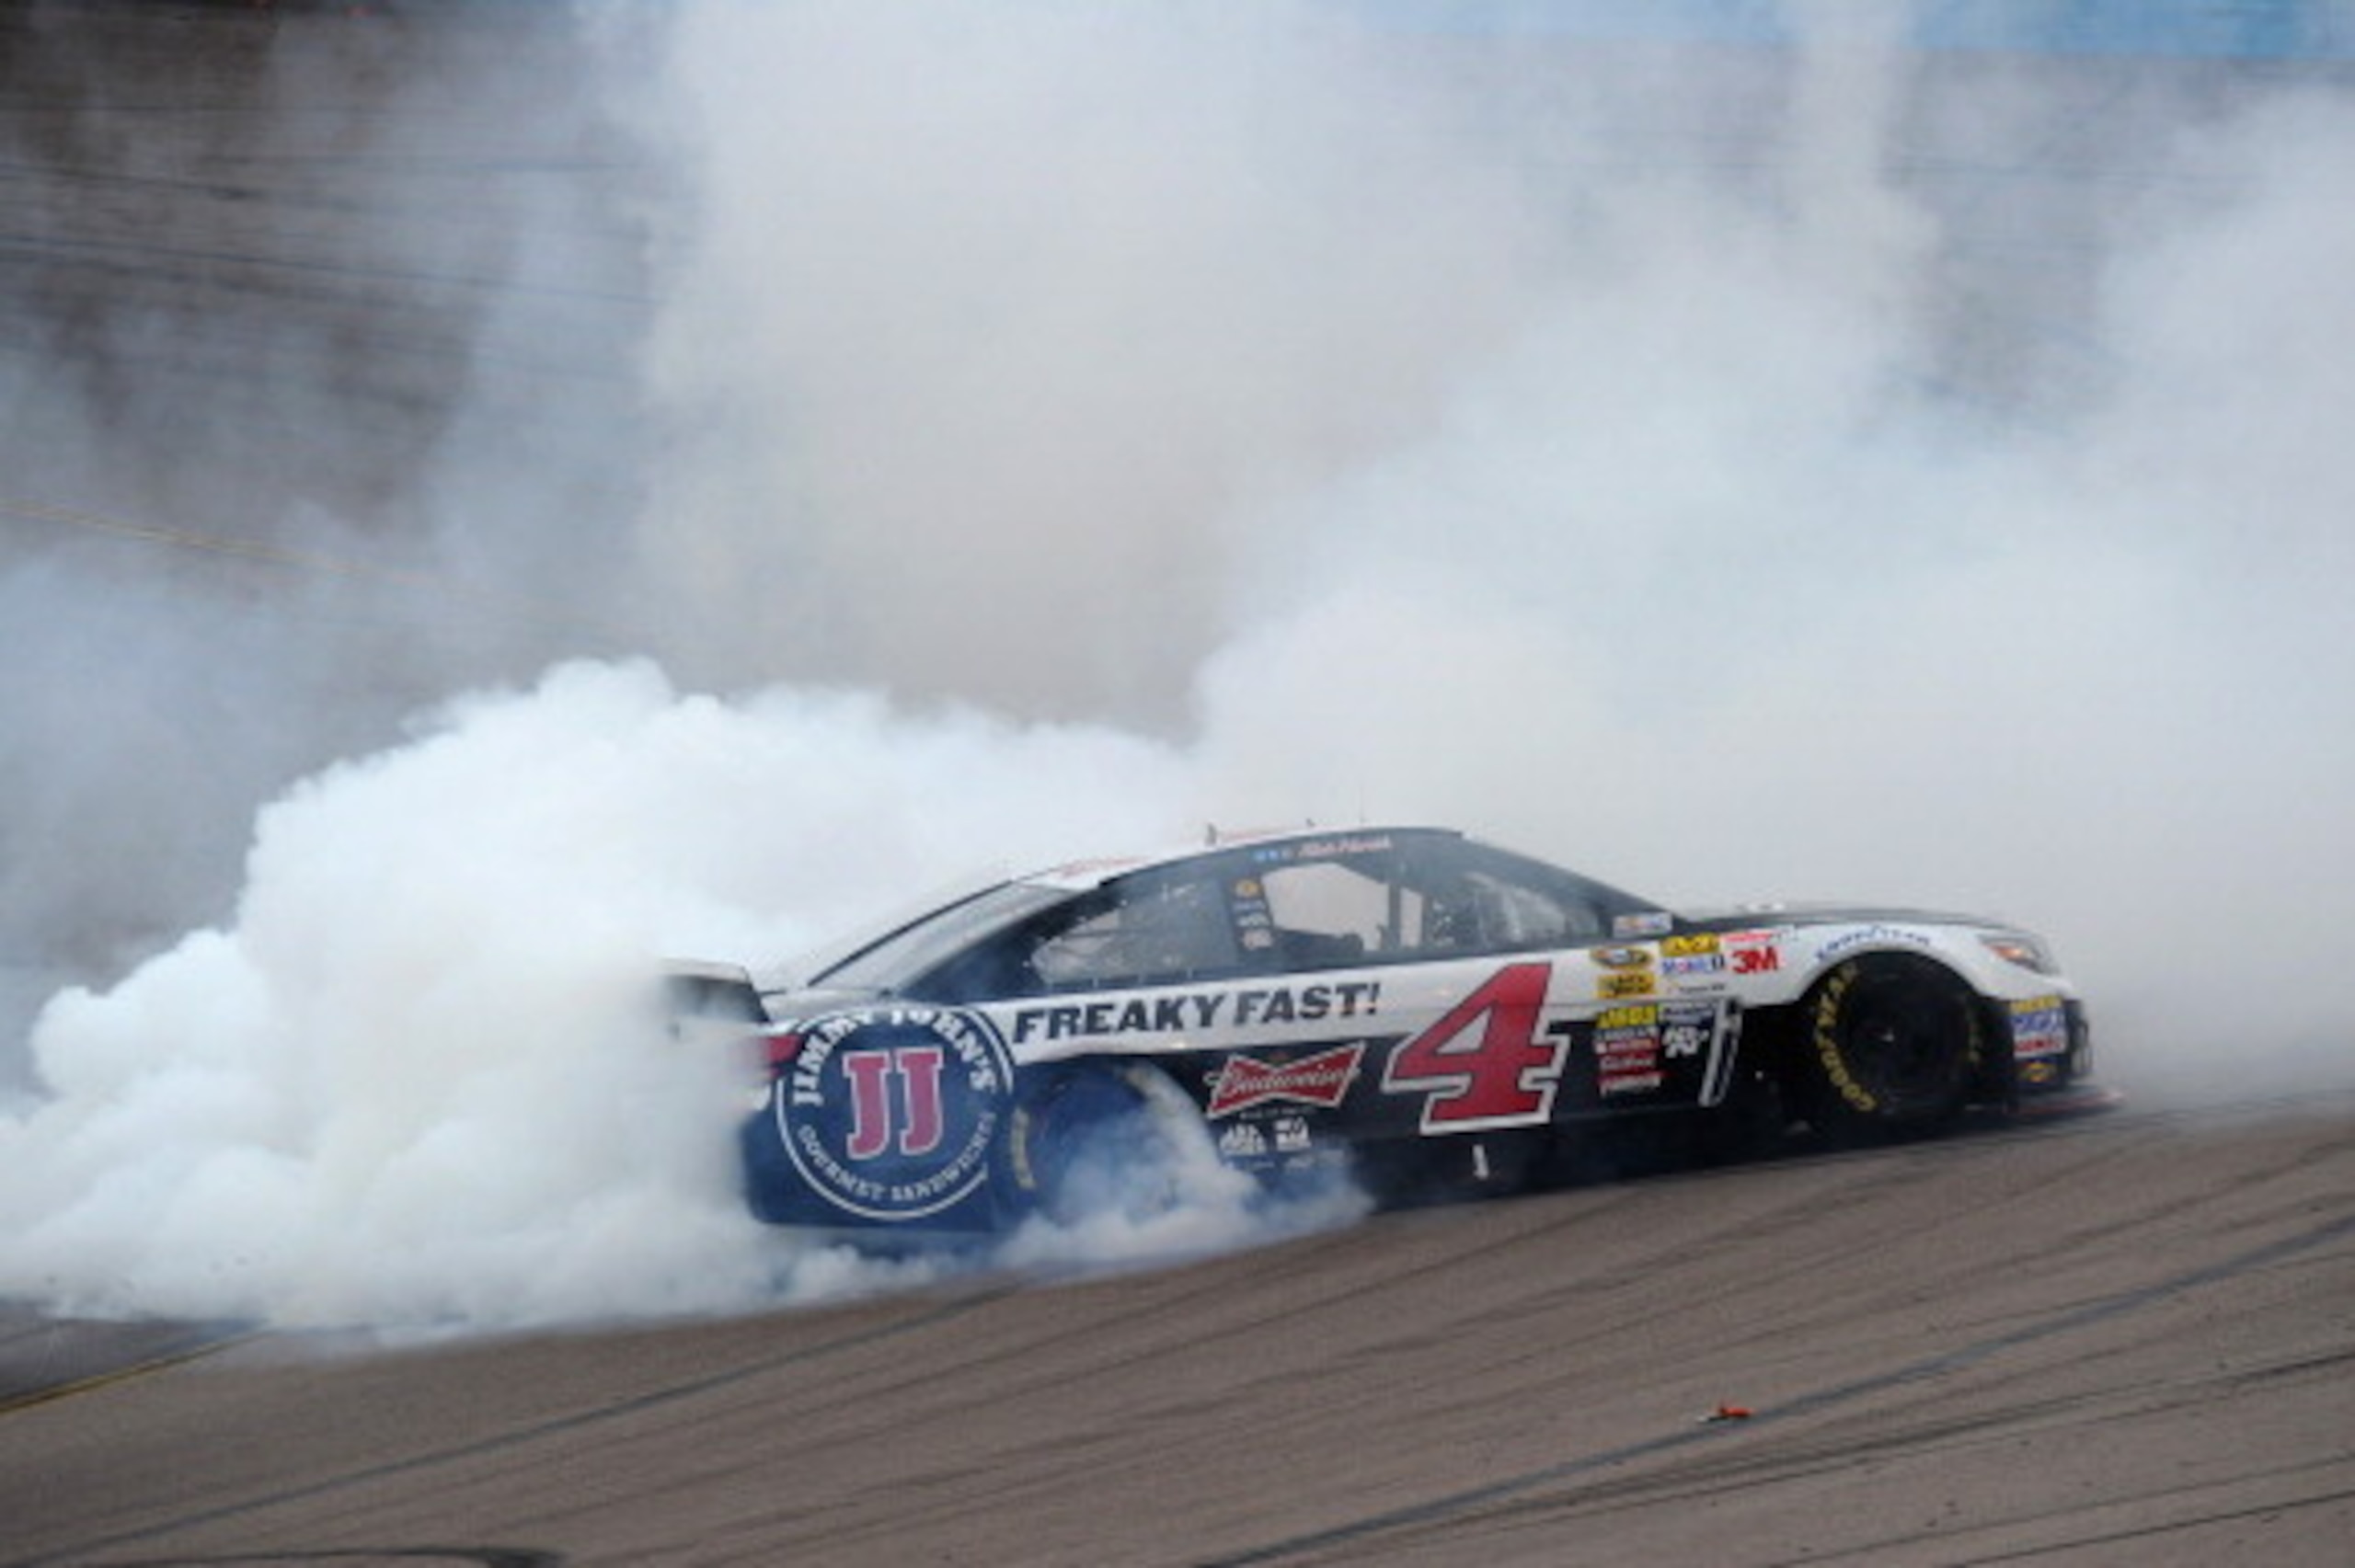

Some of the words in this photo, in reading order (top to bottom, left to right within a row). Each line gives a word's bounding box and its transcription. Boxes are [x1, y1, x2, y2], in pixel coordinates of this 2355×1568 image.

[1731, 946, 1779, 974] 3M
[1012, 993, 1225, 1044] FREAKY
[1233, 981, 1381, 1026] FAST!
[1382, 958, 1571, 1137] 4
[842, 1047, 945, 1162] JJ
[1202, 1067, 1362, 1101] Budweiser
[797, 1124, 886, 1201] GOURMET
